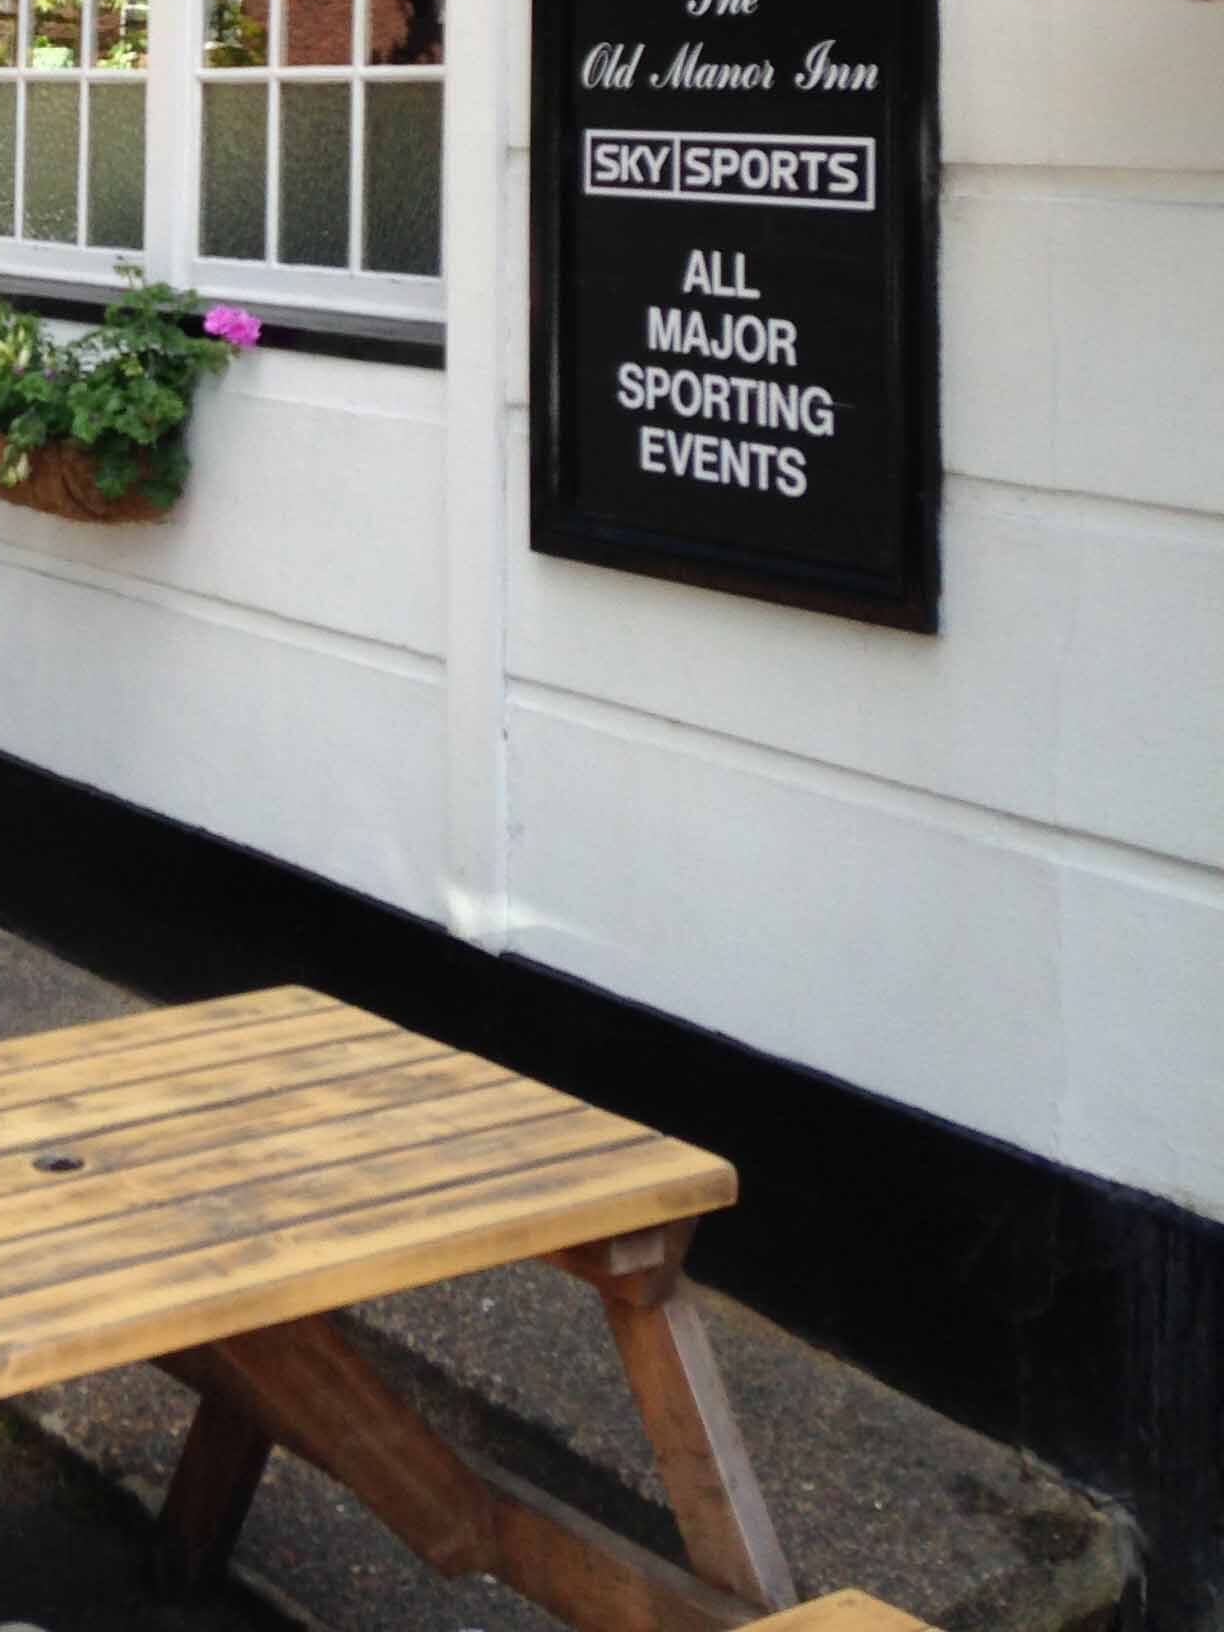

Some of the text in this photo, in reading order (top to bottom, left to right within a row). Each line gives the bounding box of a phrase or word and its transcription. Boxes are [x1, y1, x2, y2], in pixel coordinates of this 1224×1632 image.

[582, 39, 880, 91] Old Manor Inn
[594, 144, 859, 194] SKY SPORTS
[682, 249, 761, 299] ALL
[648, 305, 798, 366] MAJOR
[617, 362, 836, 437] SPORTING
[640, 425, 808, 497] EVENTS
